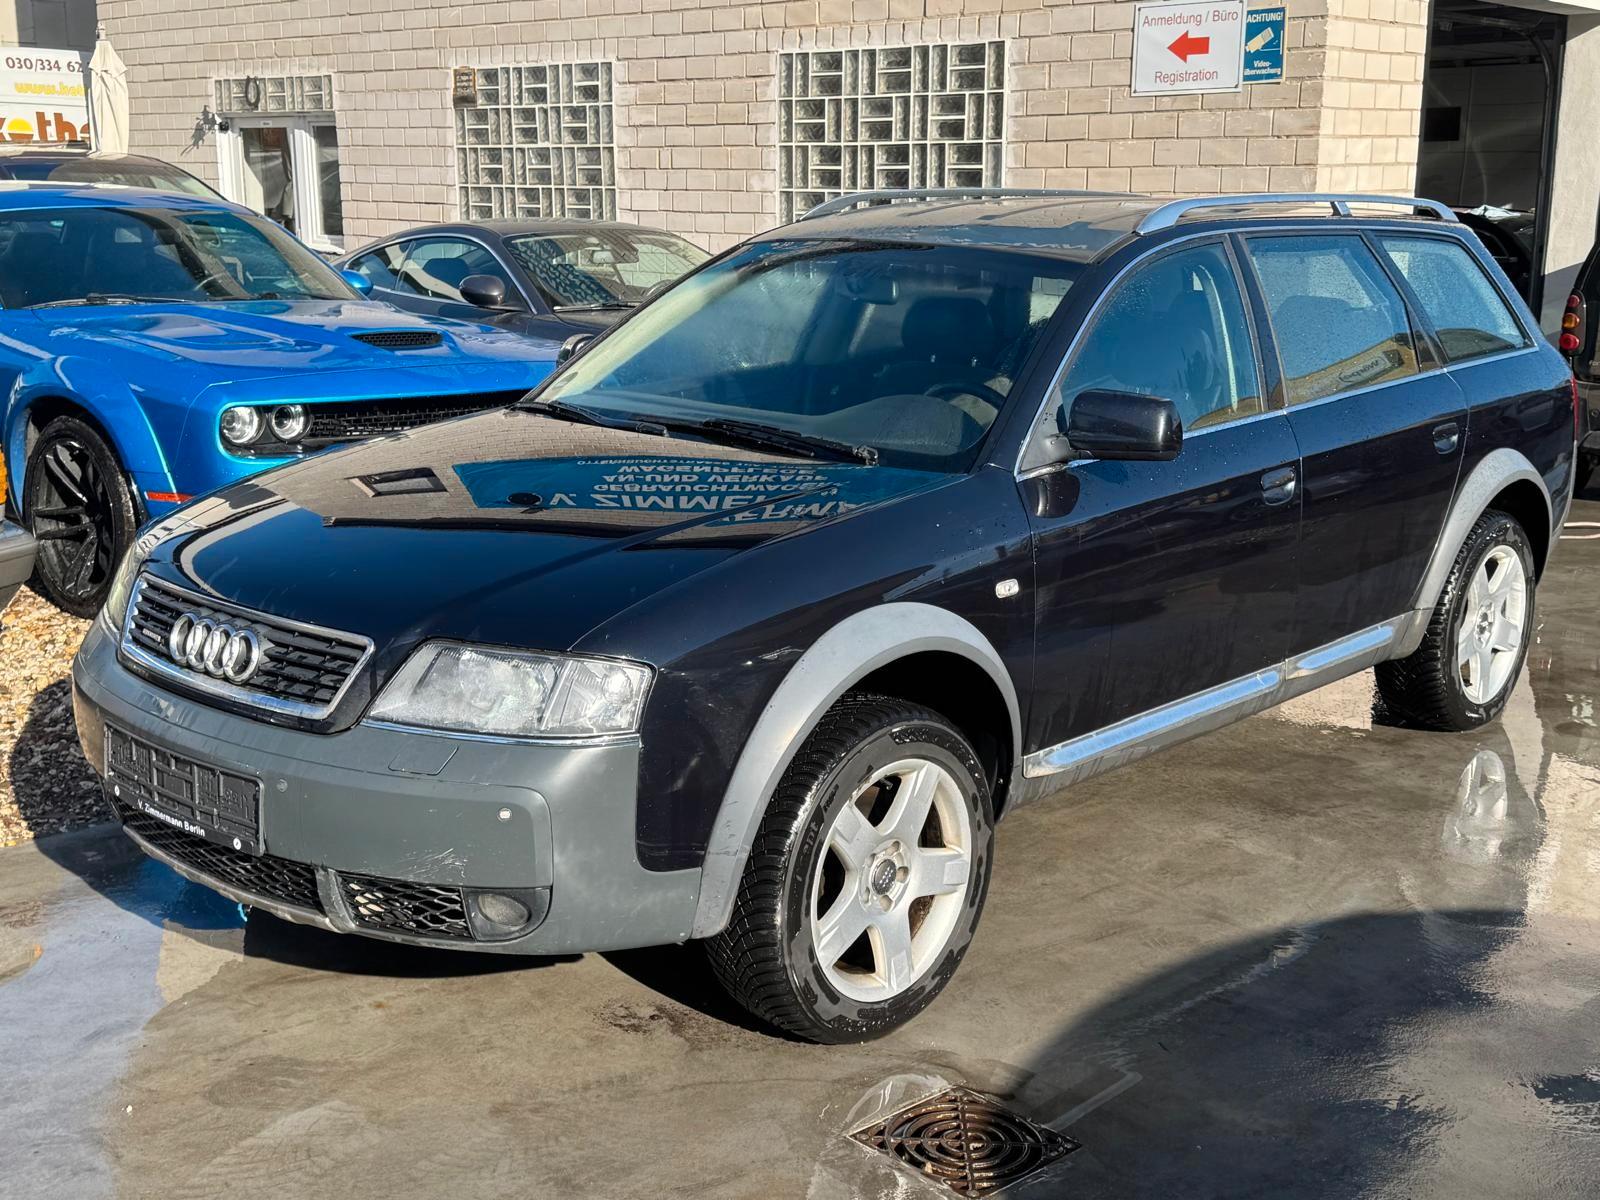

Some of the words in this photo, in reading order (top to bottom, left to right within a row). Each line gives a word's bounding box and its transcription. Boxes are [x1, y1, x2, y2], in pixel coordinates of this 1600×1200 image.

[1143, 13, 1202, 27] Anmeldung
[1212, 10, 1239, 22] Büro
[5, 57, 61, 72] 030/334
[1154, 69, 1218, 86] Registration
[184, 820, 205, 837] Berlin
